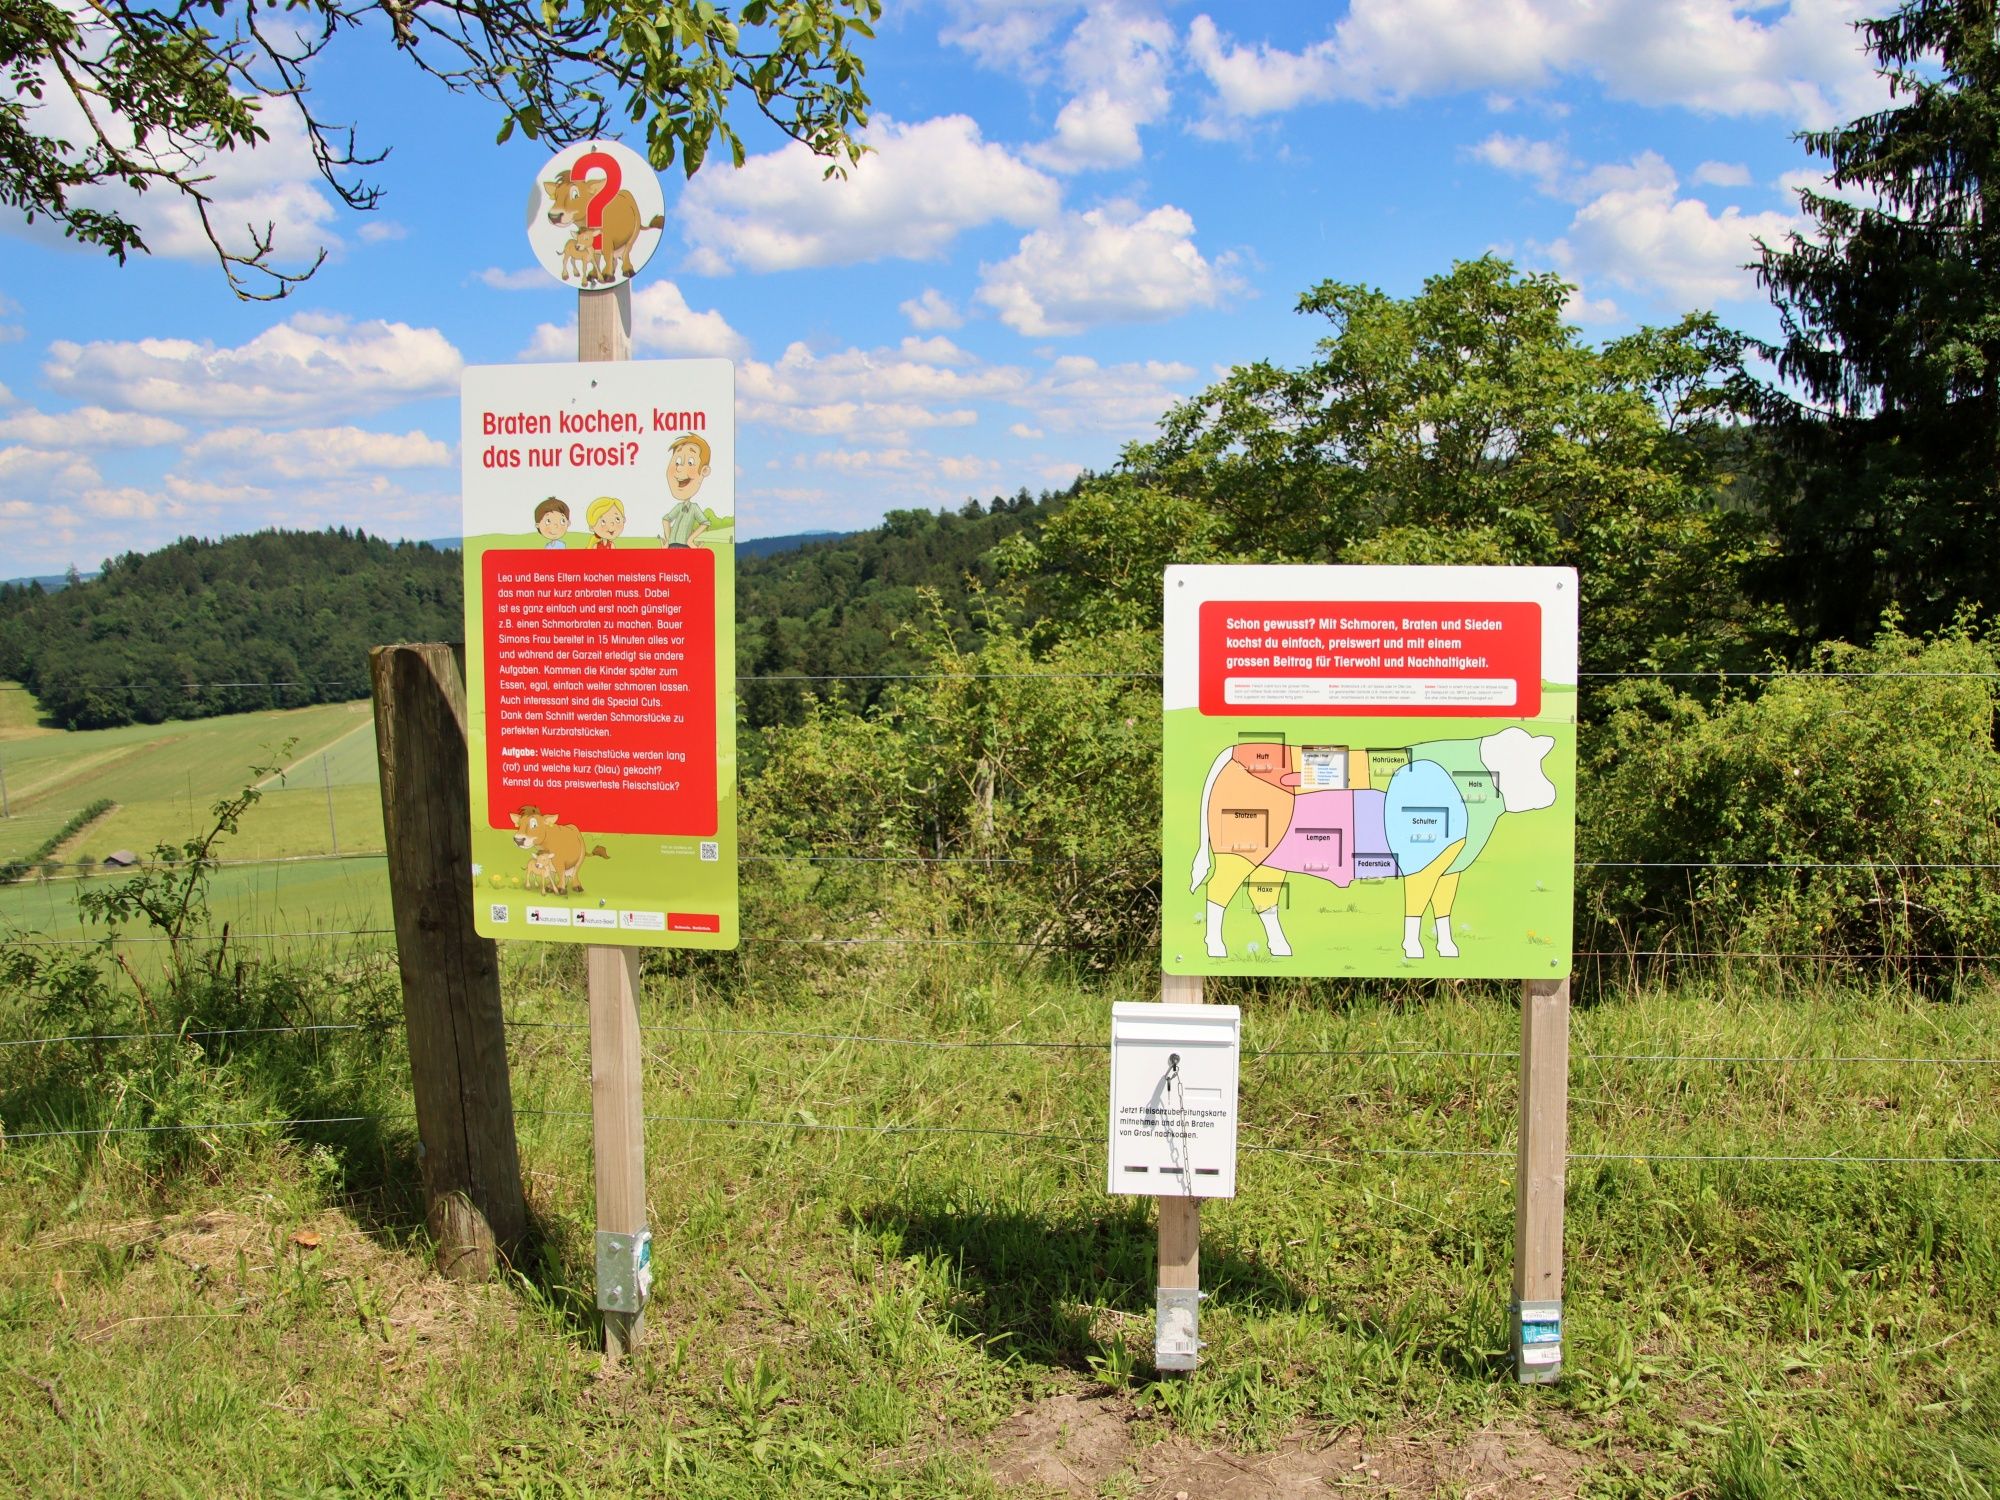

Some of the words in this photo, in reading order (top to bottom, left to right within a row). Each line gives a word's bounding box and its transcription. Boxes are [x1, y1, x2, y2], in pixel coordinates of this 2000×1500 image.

[483, 412, 550, 435] Braten
[560, 410, 643, 434] kochen,
[653, 408, 705, 431] kann
[483, 445, 521, 468] das
[528, 448, 561, 467] nur
[569, 443, 639, 466] Grosi?
[497, 573, 512, 582] Lea
[515, 573, 531, 582] und
[533, 572, 554, 582] Bens
[557, 572, 580, 582] Eltern
[583, 572, 614, 581] kochen
[617, 573, 656, 582] meistens
[658, 572, 691, 582] Fleisch,
[497, 588, 513, 597] das
[553, 588, 571, 597] kurz
[574, 588, 612, 597] anbraten
[644, 588, 669, 597] Dabei
[498, 604, 508, 612] ist
[522, 605, 543, 615] ganz
[546, 603, 576, 612] einfach
[579, 604, 595, 613] und
[598, 604, 614, 613] erst
[616, 604, 638, 613] noch
[640, 604, 681, 615] günstiger
[498, 618, 513, 628] z.B.
[516, 619, 539, 628] einen
[542, 618, 600, 628] Schmorbraten
[616, 619, 653, 628] machen.
[657, 619, 682, 629] Bauer
[1226, 617, 1260, 629] Schon
[1263, 618, 1315, 631] gewusst?
[1319, 618, 1336, 629] Mit
[1340, 618, 1397, 630] Schmoren,
[1402, 618, 1437, 629] Braten
[1441, 619, 1461, 629] und
[1464, 618, 1502, 630] Sieden
[498, 634, 529, 643] Simons
[532, 634, 550, 643] Frau
[553, 634, 584, 643] bereitet
[586, 635, 594, 643] in
[598, 634, 608, 644] 15
[611, 634, 644, 644] Minuten
[647, 635, 668, 644] alles
[1226, 636, 1262, 648] kochst
[1264, 637, 1278, 648] du
[1281, 637, 1324, 649] einfach,
[1328, 637, 1380, 650] preiswert
[1383, 637, 1403, 648] und
[1407, 637, 1424, 648] mit
[1427, 637, 1461, 648] einem
[499, 650, 515, 658] und
[517, 650, 553, 659] während
[556, 650, 569, 659] der
[572, 650, 602, 659] Garzeit
[604, 650, 636, 662] erledigt
[638, 651, 651, 660] sie
[653, 650, 683, 660] andere
[1226, 657, 1269, 669] grossen
[1273, 655, 1312, 669] Beitrag
[1315, 655, 1331, 666] für
[1333, 656, 1380, 667] Tierwohl
[1384, 656, 1404, 667] und
[1407, 656, 1488, 669] Nachhaltigkeit.
[499, 664, 540, 676] Aufgaben.
[544, 665, 581, 674] Kommen
[584, 665, 597, 674] die
[599, 666, 626, 675] Kinder
[629, 666, 656, 677] später
[500, 679, 526, 689] Essen,
[529, 680, 549, 691] egal,
[553, 680, 583, 690] einfach
[586, 681, 611, 690] weiter
[614, 681, 656, 691] schmoren
[659, 682, 690, 691] lassen.
[500, 695, 520, 704] Auch
[523, 696, 568, 705] interessant
[571, 696, 589, 705] sind
[591, 696, 604, 705] die
[607, 696, 638, 708] Special
[640, 697, 662, 706] Cuts.
[500, 710, 522, 719] Dank
[524, 711, 543, 720] dem
[545, 711, 574, 720] Schnitt
[576, 711, 607, 721] werden
[610, 712, 670, 722] Schmorstücke
[501, 725, 539, 736] perfekten
[541, 726, 612, 736] Kurzbratstücken.
[501, 746, 537, 758] Aufgabe:
[540, 748, 570, 757] Welche
[573, 748, 629, 758] Fleischstücke
[632, 750, 663, 759] werden
[666, 751, 685, 762] lang
[502, 762, 520, 772] (rot)
[523, 762, 539, 771] und
[541, 763, 570, 772] welche
[573, 764, 591, 773] kurz
[594, 764, 620, 775] (blau)
[623, 765, 661, 776] gekocht?
[502, 777, 530, 786] Kennst
[532, 778, 543, 787] du
[546, 778, 561, 787] das
[564, 779, 619, 789] preiswerteste
[622, 780, 679, 790] Fleischstück?
